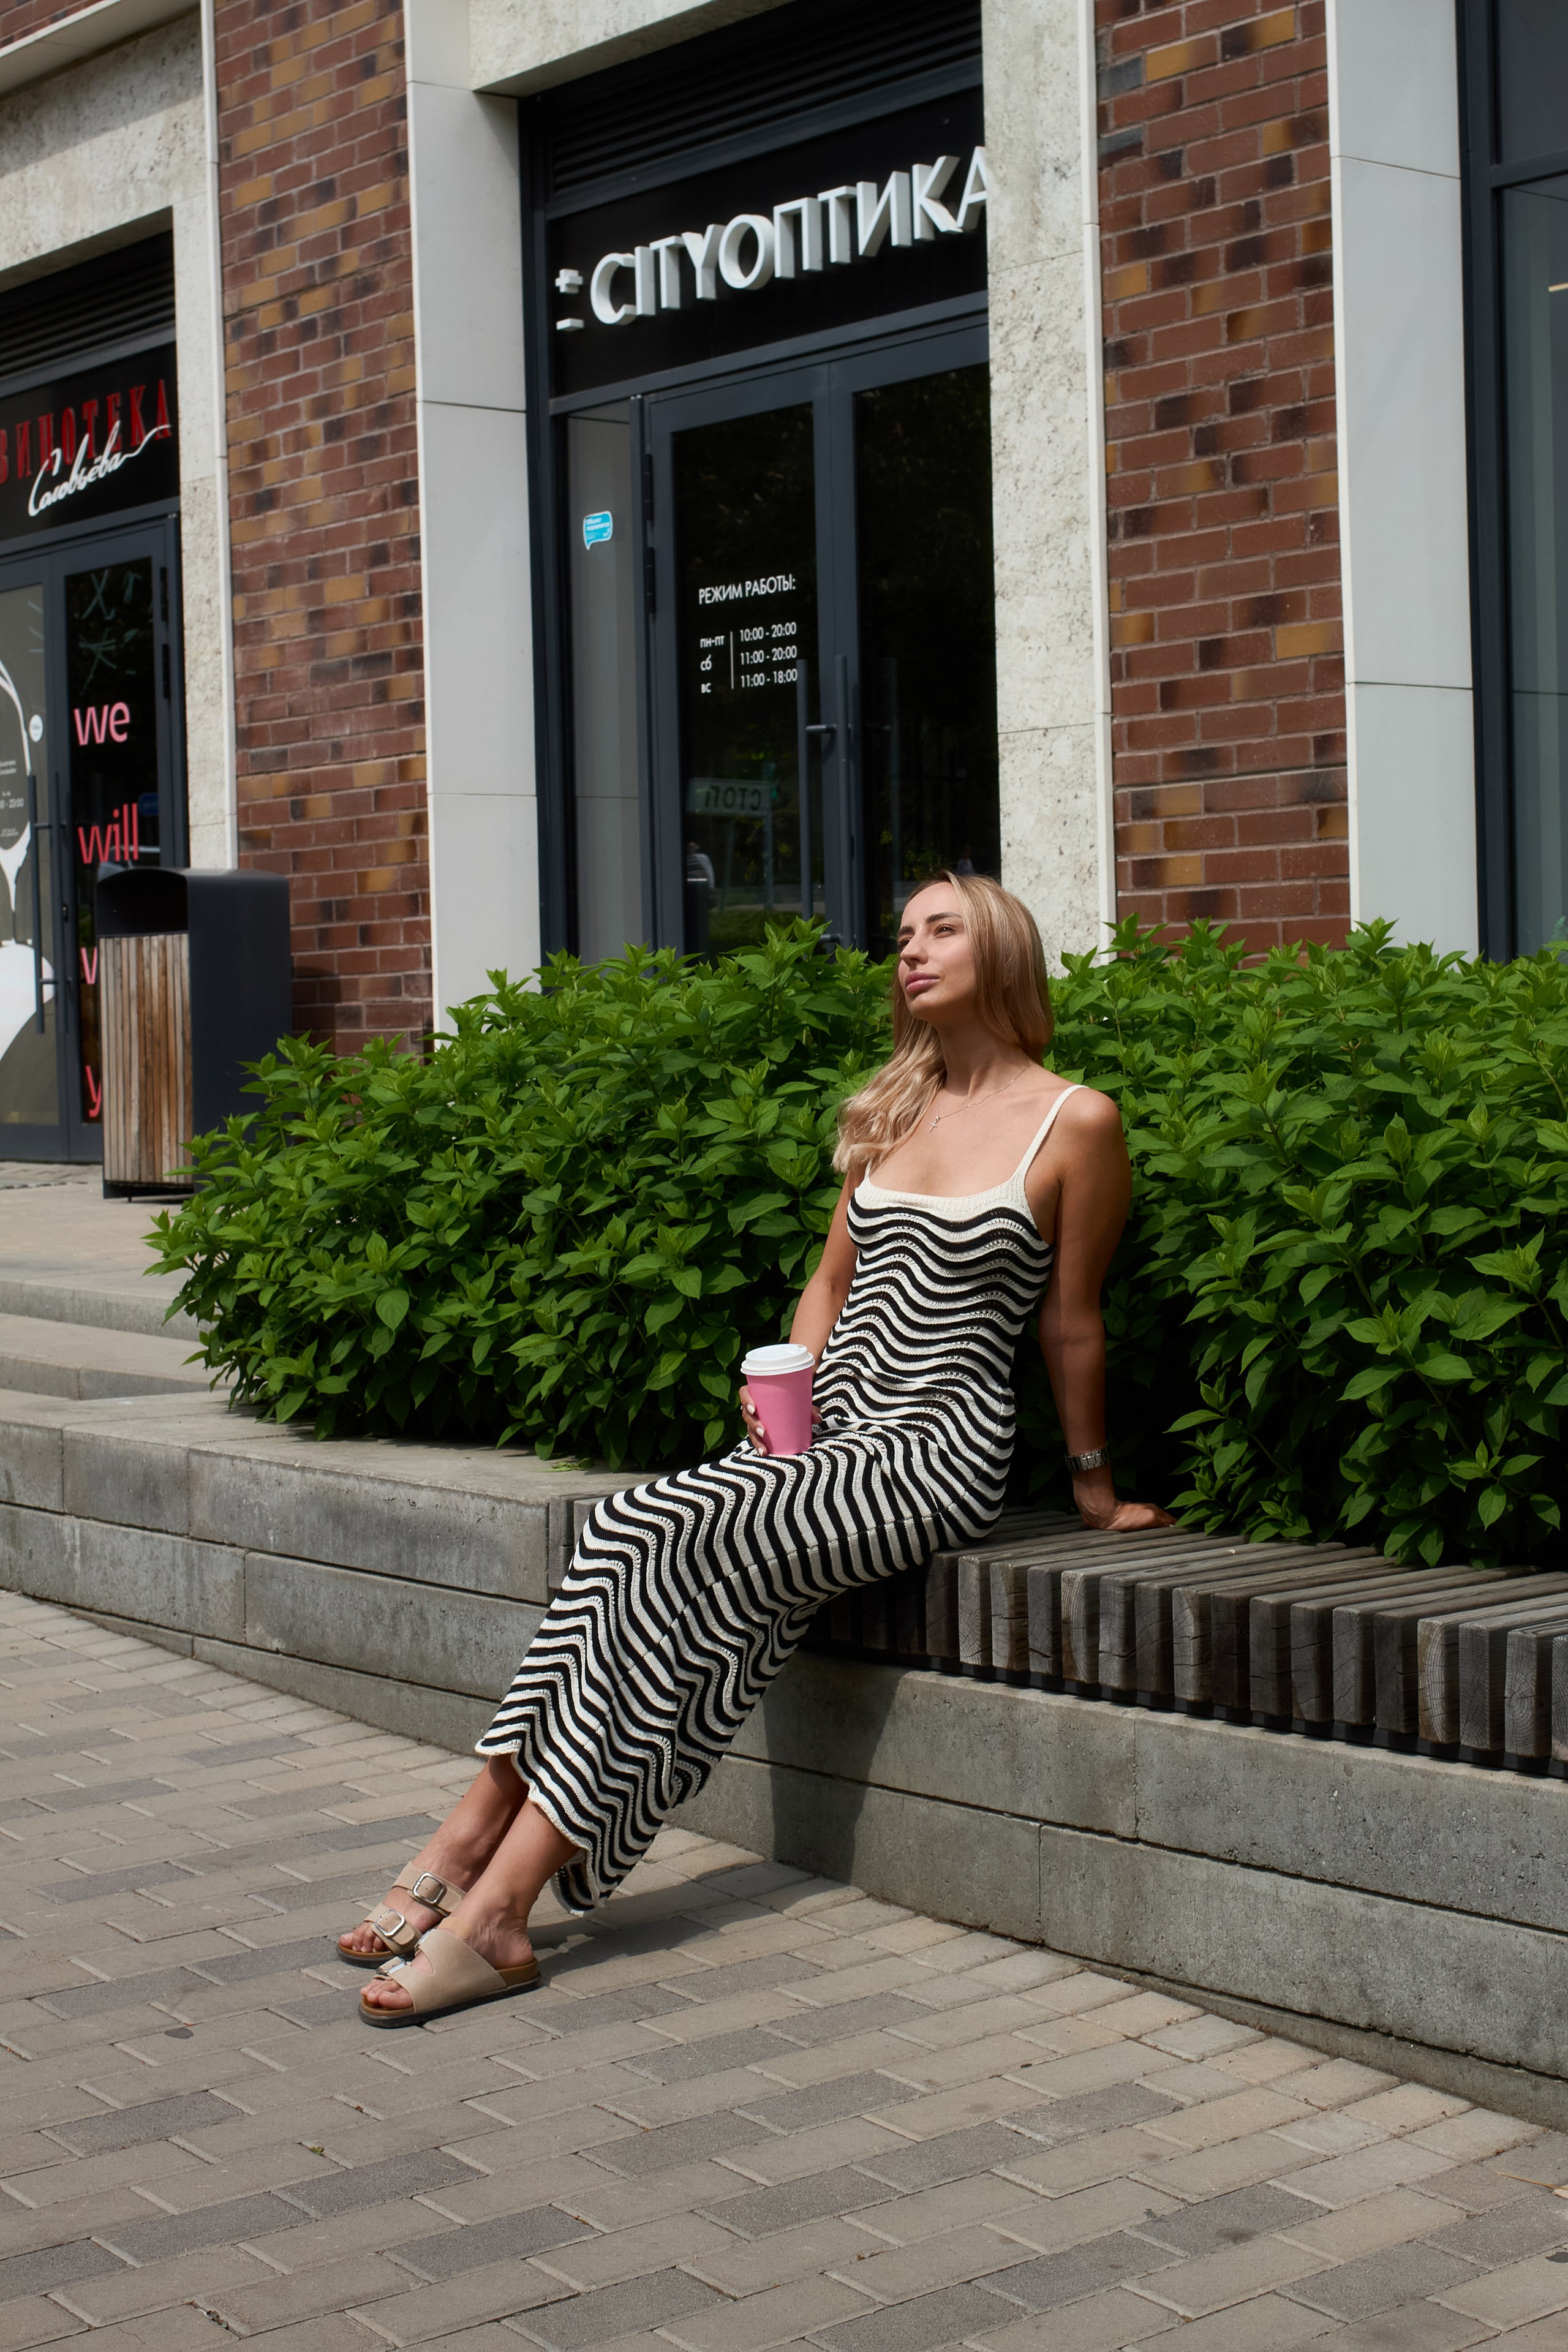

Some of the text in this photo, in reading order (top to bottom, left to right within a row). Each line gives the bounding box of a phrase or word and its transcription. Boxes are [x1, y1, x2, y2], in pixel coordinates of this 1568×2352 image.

[699, 574, 796, 604] РЕЖИМ РАБОТЫ:
[700, 636, 725, 648] пн-пт
[740, 627, 764, 642] 10:00
[771, 622, 796, 638] 20:00
[701, 654, 712, 671] сб
[741, 650, 764, 665] 11:00
[772, 645, 797, 661] 20:00
[701, 683, 711, 693] вс
[741, 673, 764, 688] 11:00
[773, 668, 797, 684] 18:00
[74, 702, 130, 745] we
[78, 803, 138, 864] will
